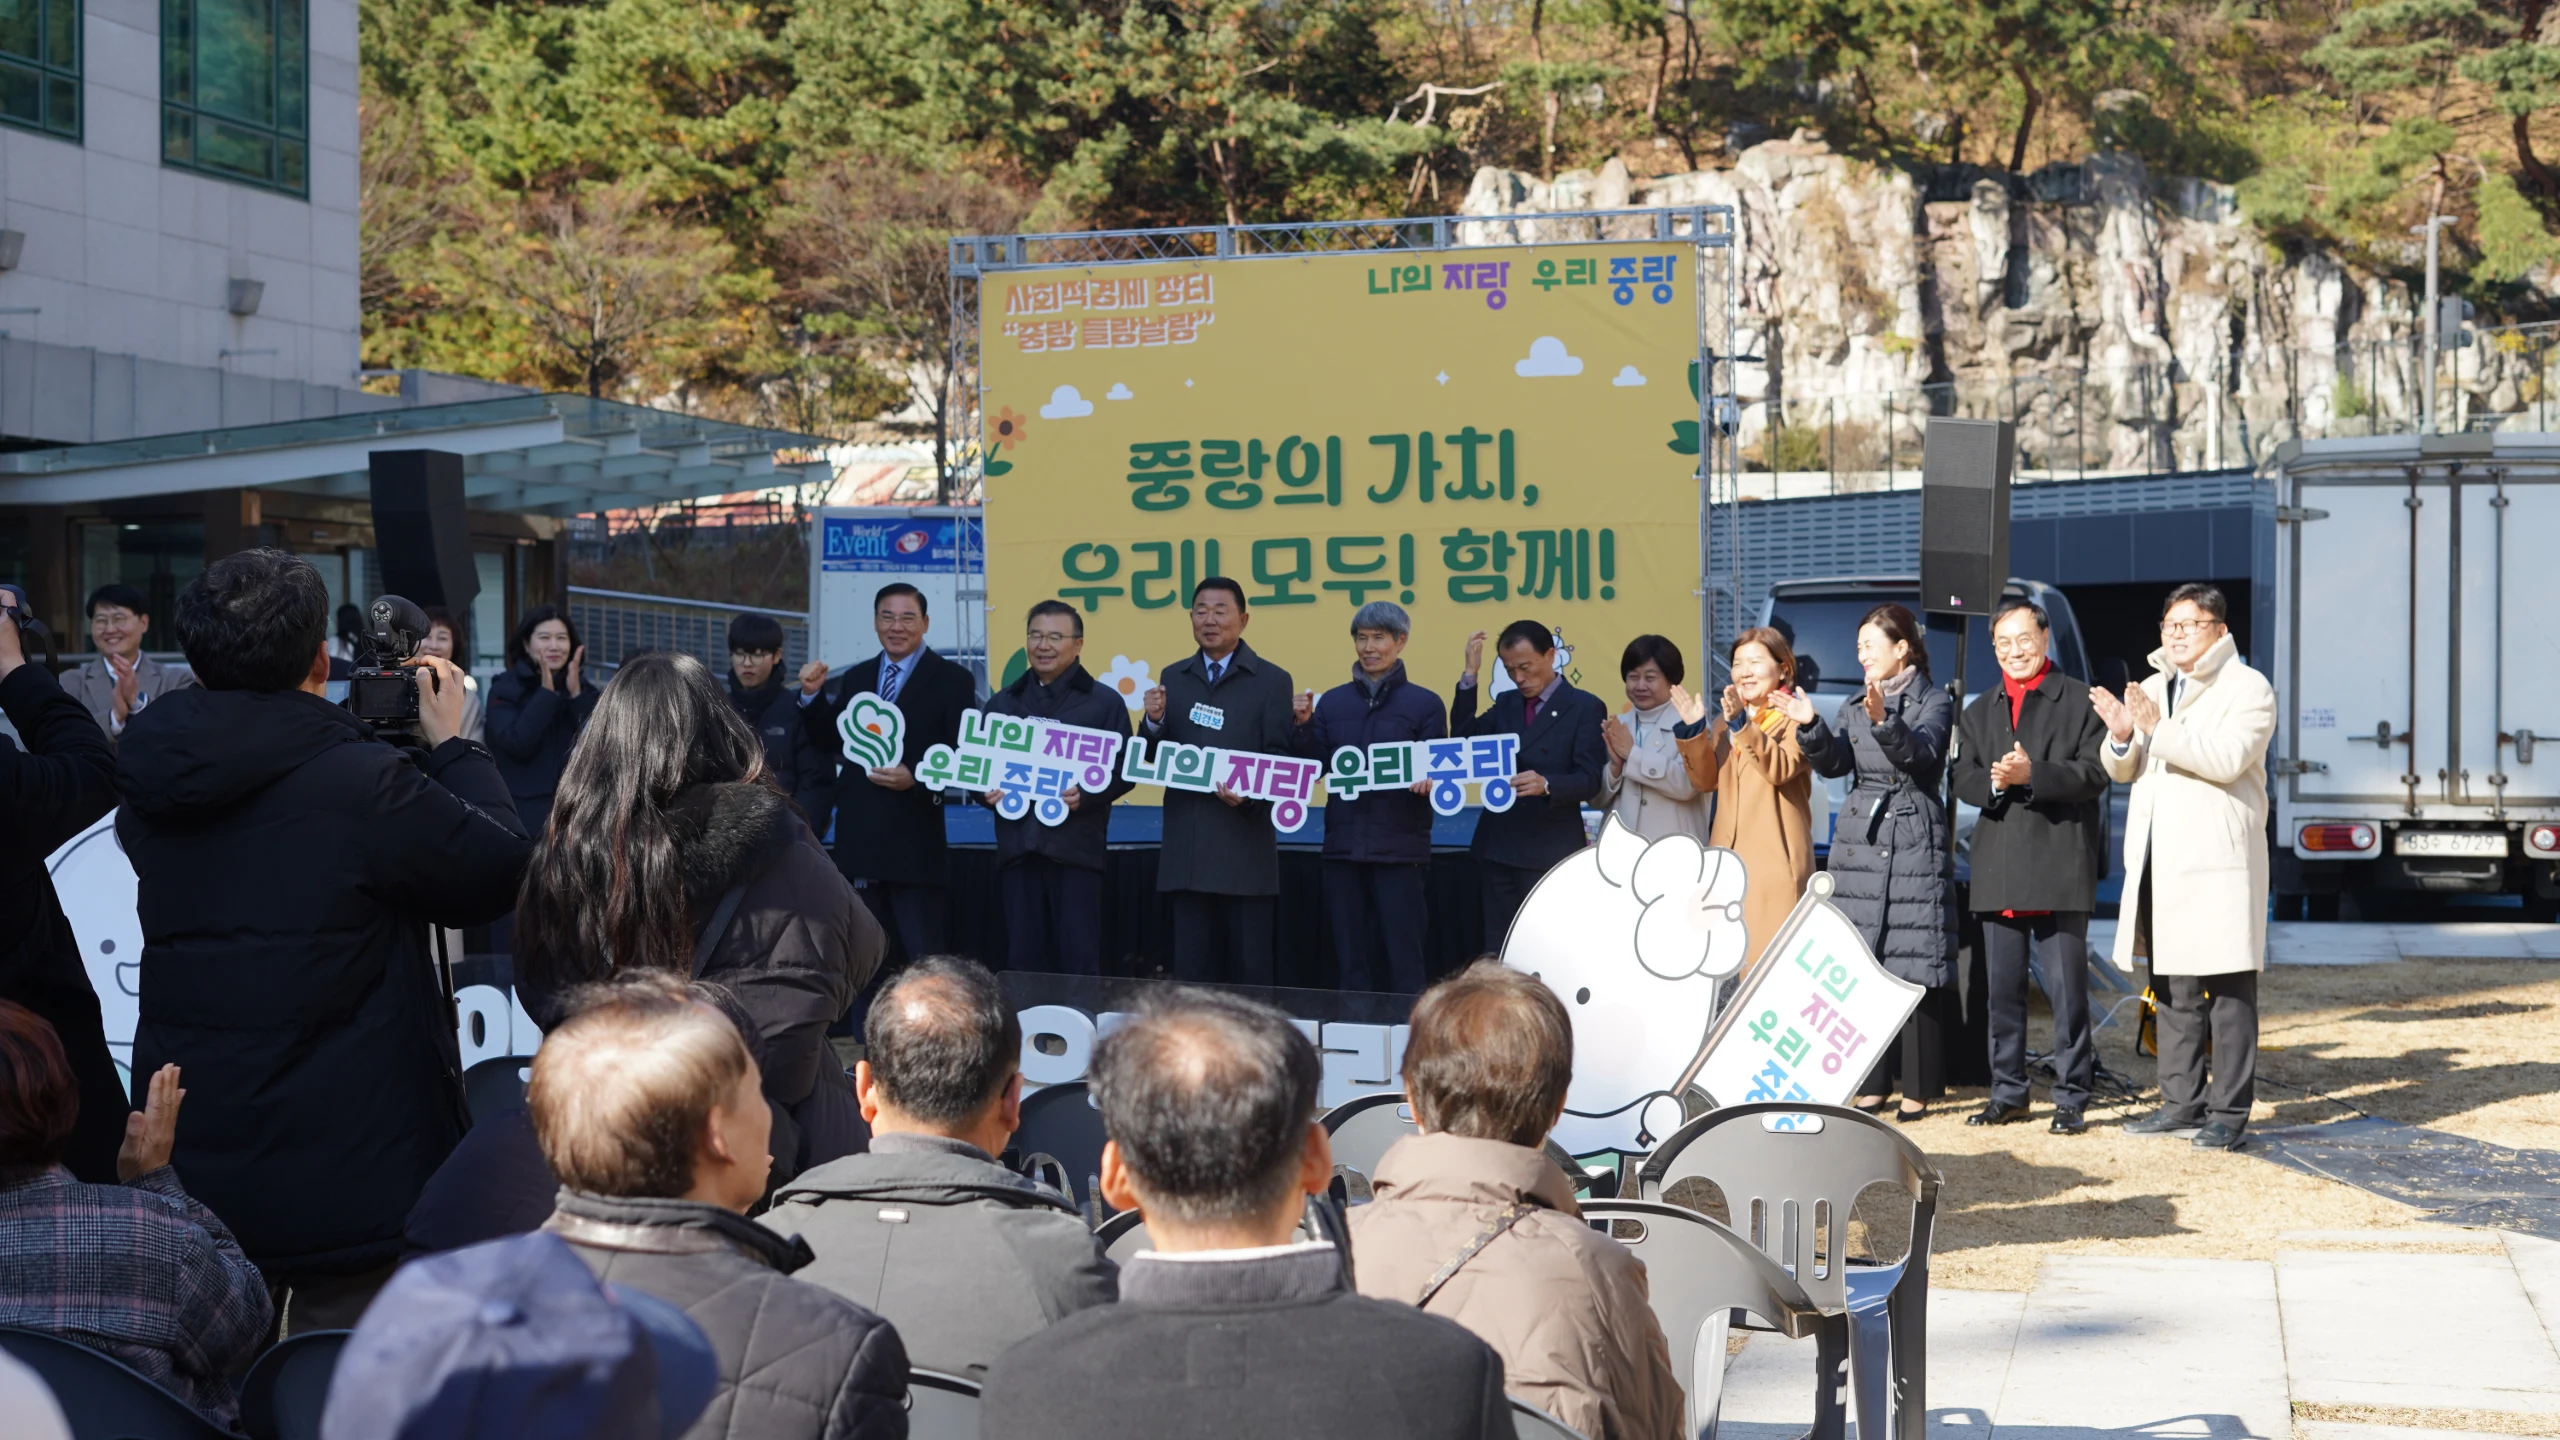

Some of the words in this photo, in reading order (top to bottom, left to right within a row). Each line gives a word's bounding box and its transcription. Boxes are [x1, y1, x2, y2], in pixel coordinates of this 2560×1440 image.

[1005, 279, 1149, 317] 사회적경제
[1155, 272, 1215, 307] 장터
[1368, 264, 1432, 295] 나의
[1442, 261, 1511, 311] 자랑
[1532, 258, 1597, 292] 우리
[1608, 255, 1678, 306] 중랑
[1126, 434, 1342, 512] 중랑의
[1366, 426, 1540, 508] 가치,
[828, 526, 890, 557] Event
[1247, 532, 1416, 608] 모두!
[1439, 527, 1617, 604] 함께!
[922, 750, 992, 786] 우리
[999, 761, 1075, 821] 중랑
[964, 715, 1035, 753] 나의
[1042, 728, 1117, 787] 자랑
[1126, 741, 1215, 788] 나의
[1224, 754, 1317, 829] 자랑
[1329, 746, 1413, 795] 우리
[1427, 738, 1516, 811] 중랑
[2450, 835, 2495, 851] 6729
[1794, 938, 1860, 1003] 나의
[1748, 1009, 1812, 1069] 우리
[1799, 992, 1868, 1075] 자랑
